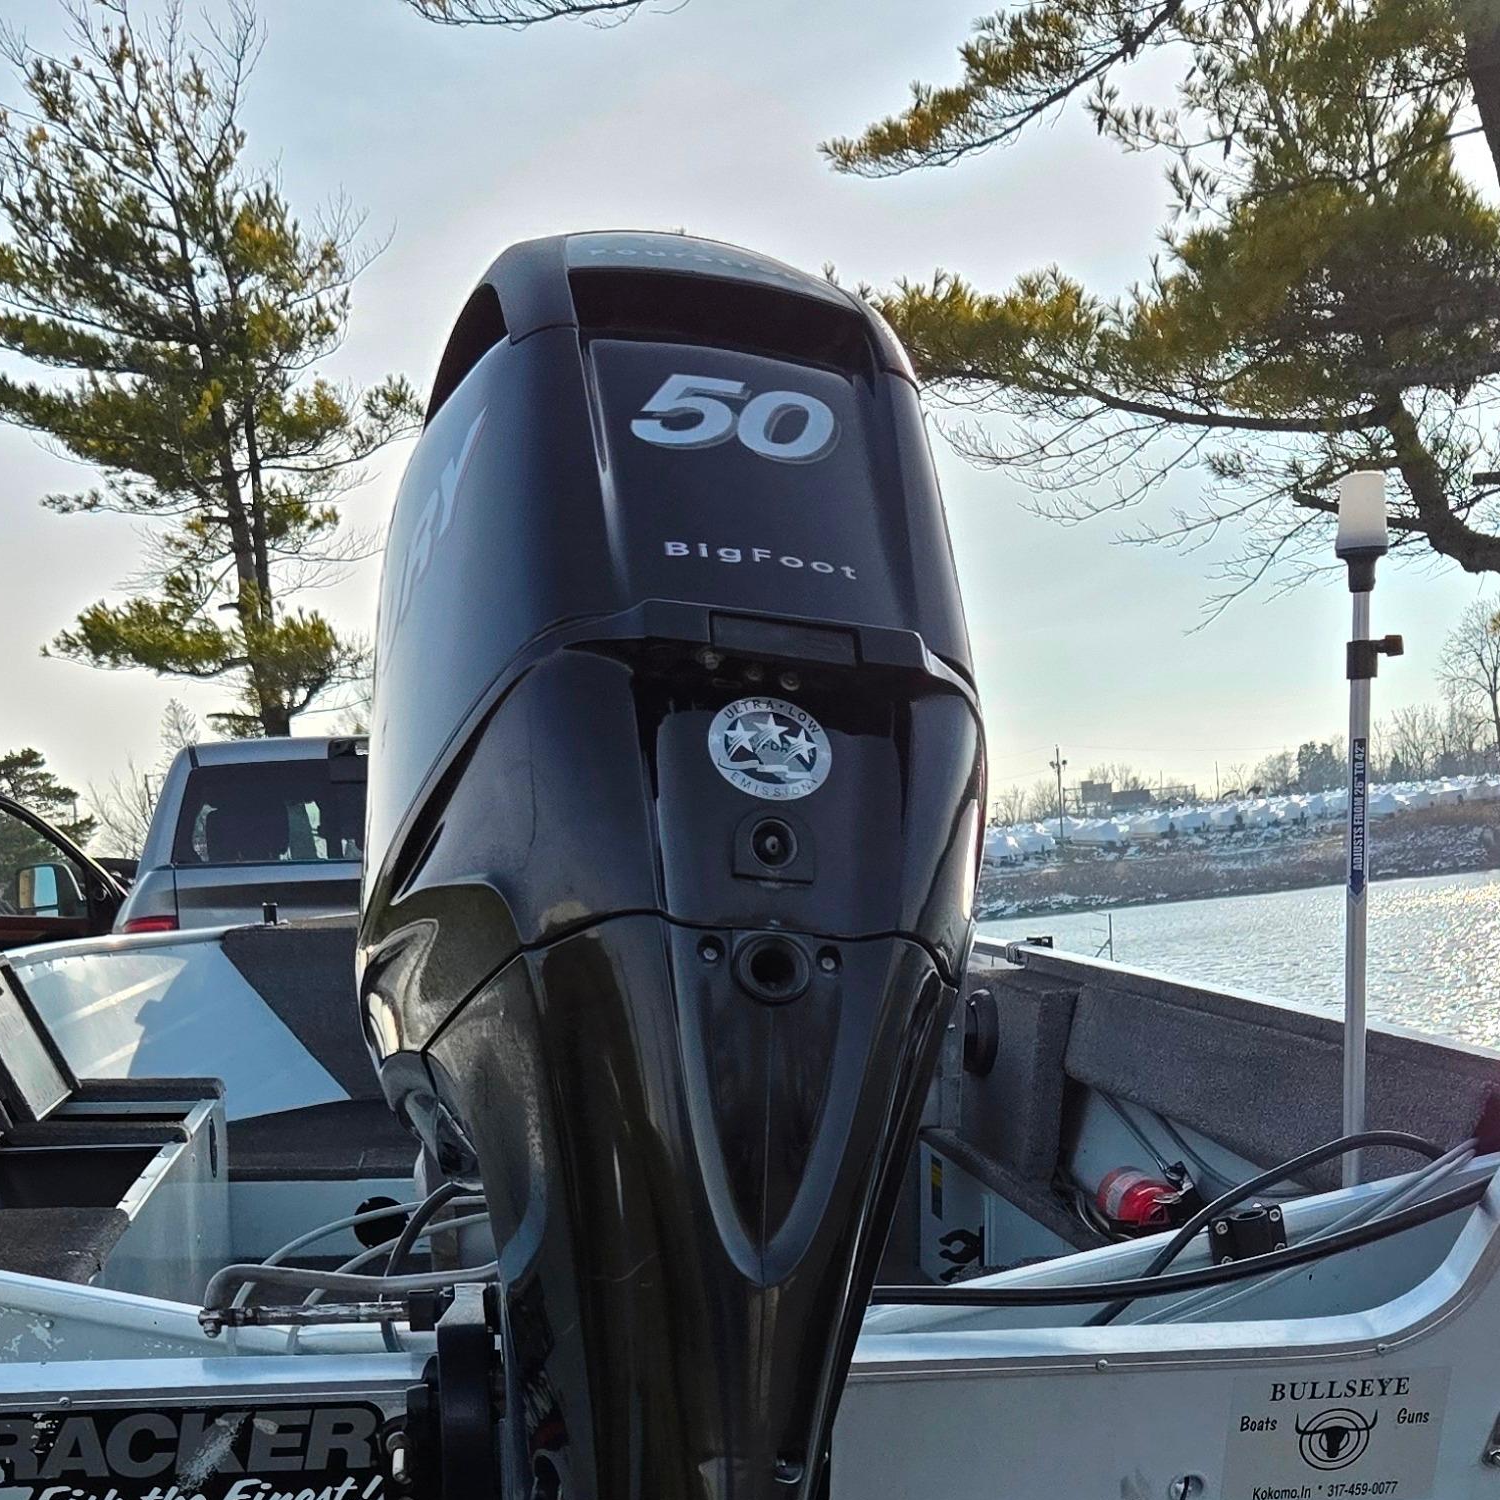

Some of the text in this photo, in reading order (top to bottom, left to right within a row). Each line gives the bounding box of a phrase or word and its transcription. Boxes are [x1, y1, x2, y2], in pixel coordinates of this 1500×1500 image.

[631, 373, 840, 463] 50
[663, 541, 857, 580] BigFoot
[723, 700, 821, 734] ULTRA LOW
[1354, 761, 1364, 775] TO
[1353, 796, 1364, 826] FROM
[1352, 826, 1364, 871] ADJUSTS
[1269, 1376, 1410, 1402] BULLSEYE
[1239, 1415, 1278, 1432] Boats
[1397, 1407, 1430, 1424] Guns
[1327, 1481, 1399, 1498] 317-459-0077
